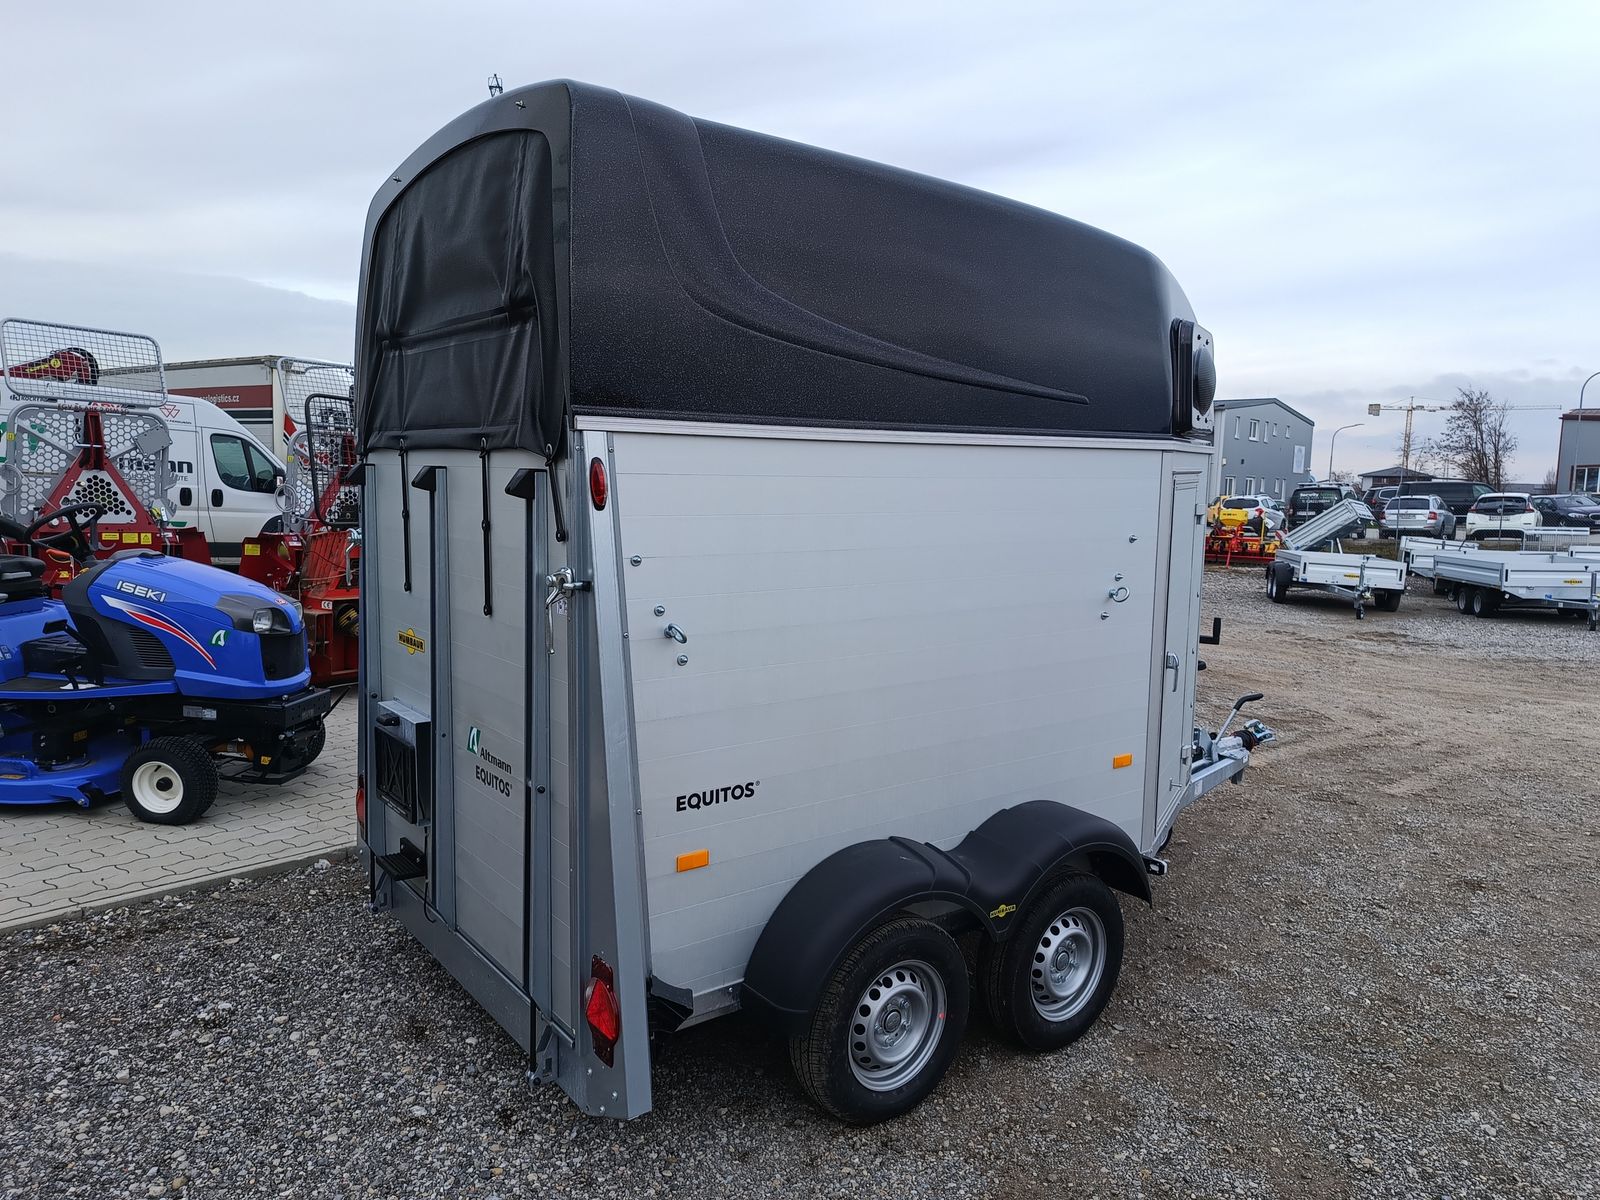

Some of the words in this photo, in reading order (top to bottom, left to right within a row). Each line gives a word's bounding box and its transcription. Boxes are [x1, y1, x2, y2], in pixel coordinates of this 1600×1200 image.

[116, 580, 166, 603] ISEKI
[398, 632, 424, 651] HUMBAUR
[480, 746, 512, 775] Altmann
[990, 904, 1016, 918] HUMBAUR
